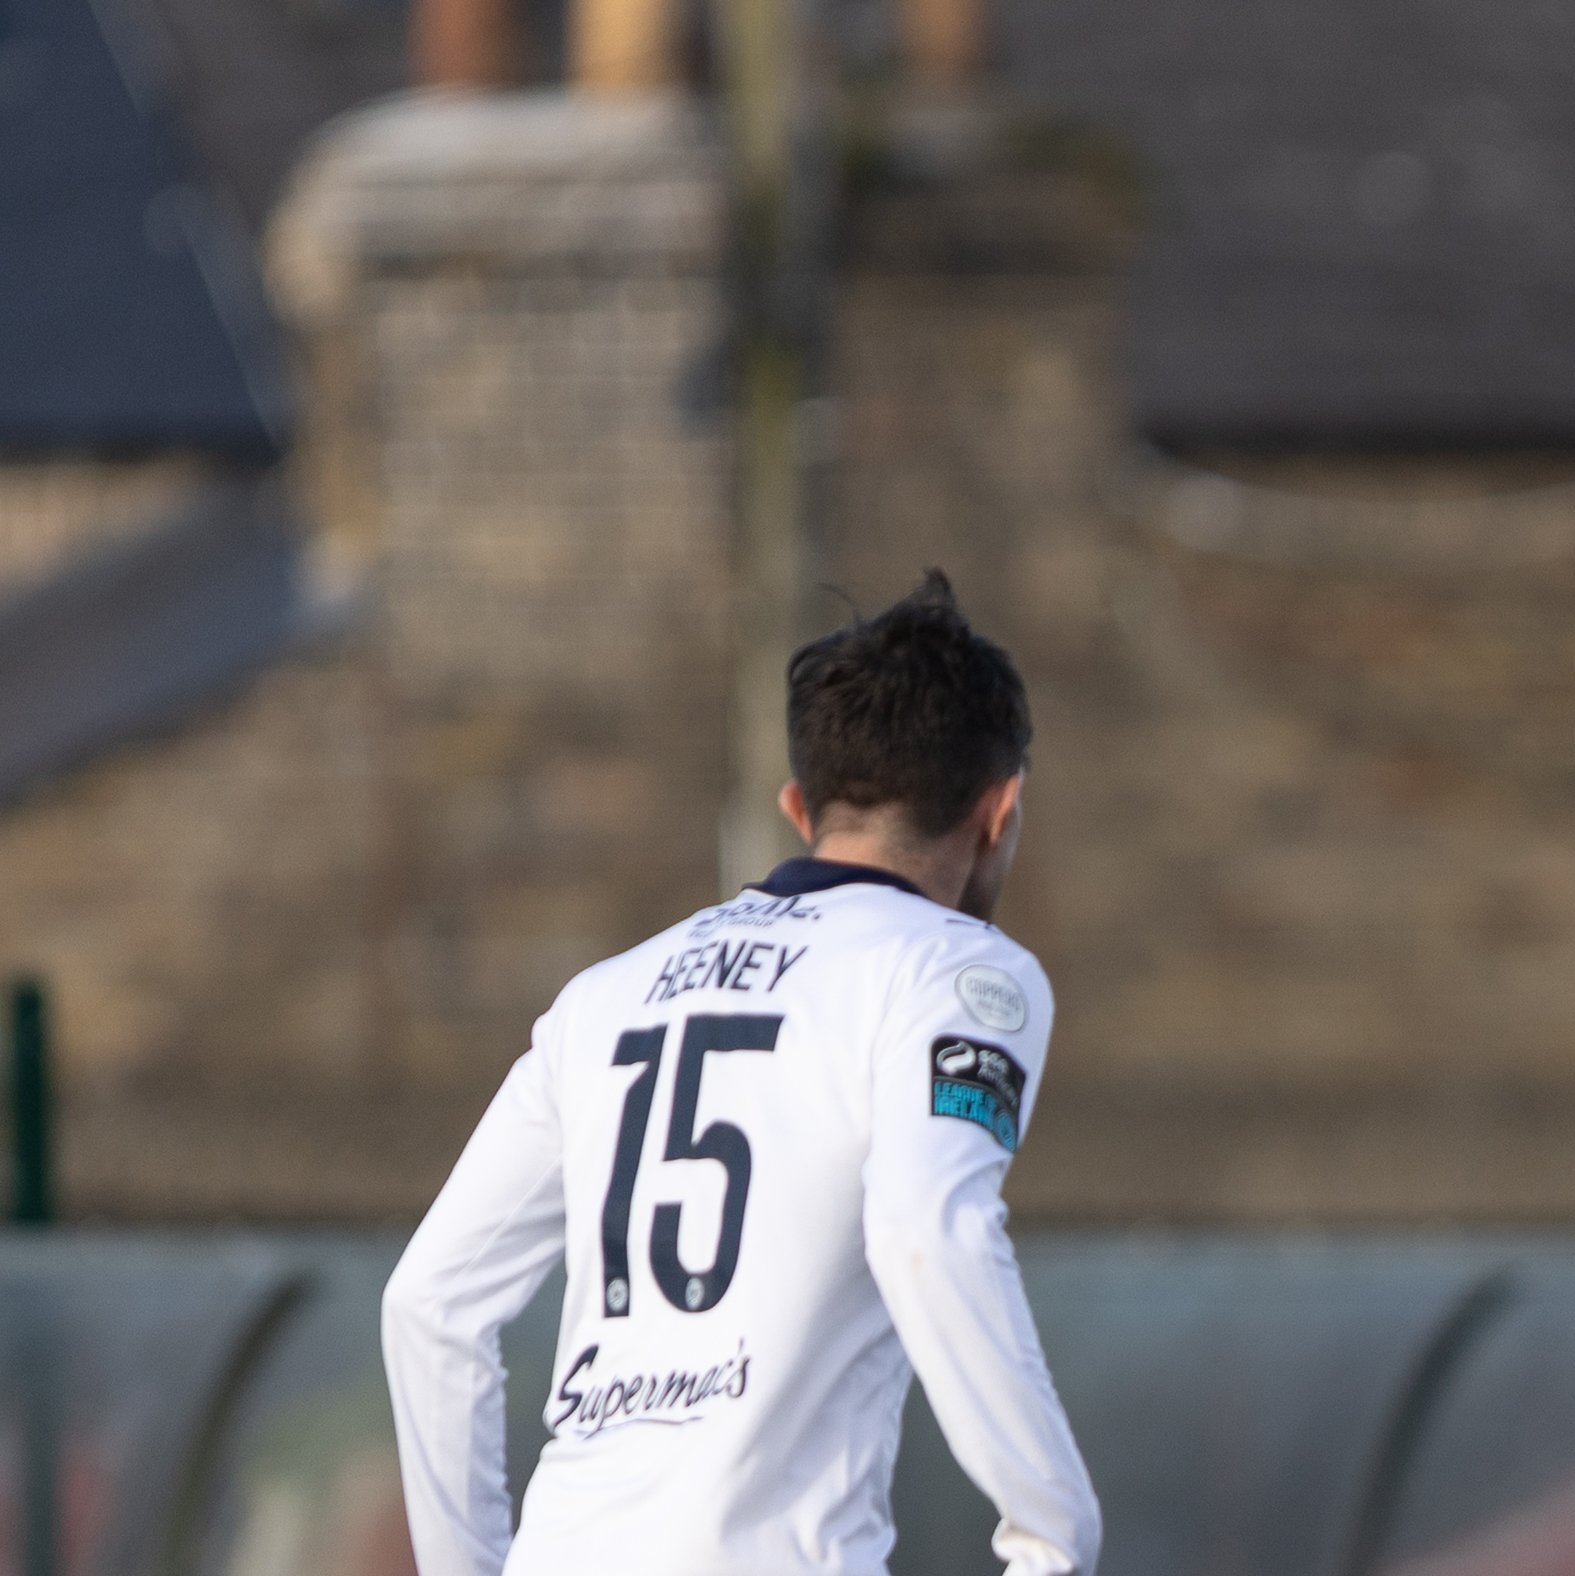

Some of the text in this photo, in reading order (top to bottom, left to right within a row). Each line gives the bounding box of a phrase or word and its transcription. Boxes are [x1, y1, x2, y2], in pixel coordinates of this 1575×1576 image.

[643, 939, 811, 1005] HEENEY
[602, 1012, 786, 1318] 15
[554, 1337, 751, 1442] Supermac's
